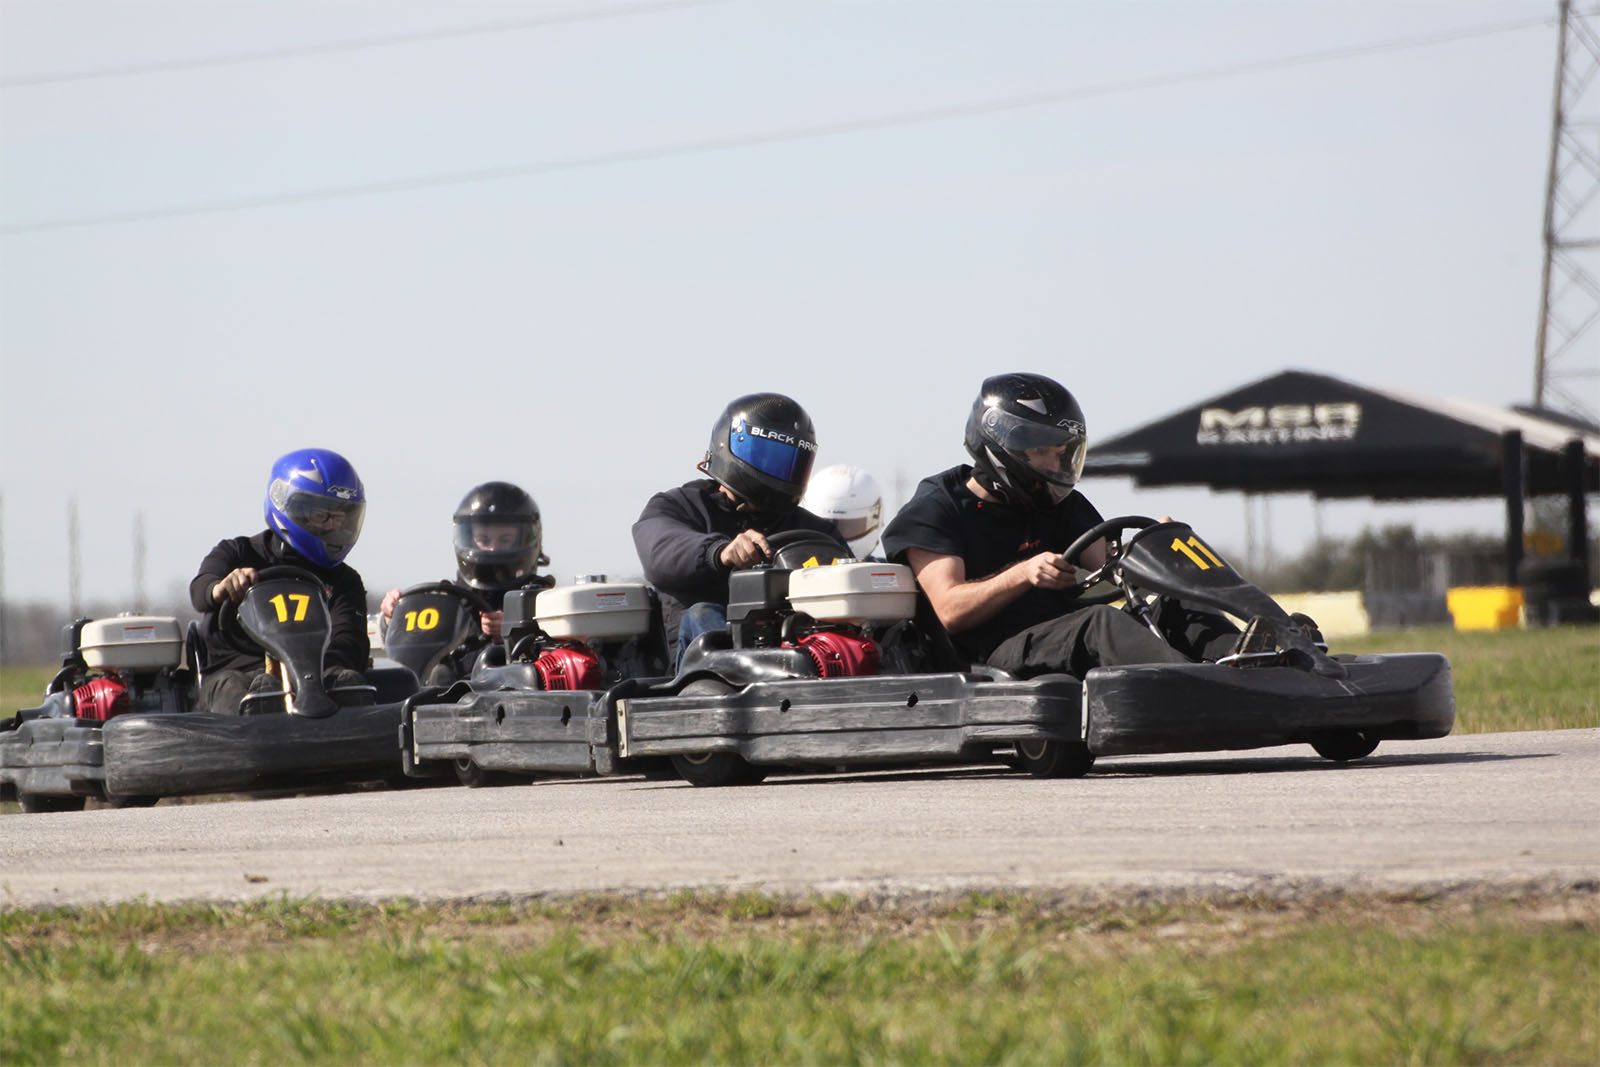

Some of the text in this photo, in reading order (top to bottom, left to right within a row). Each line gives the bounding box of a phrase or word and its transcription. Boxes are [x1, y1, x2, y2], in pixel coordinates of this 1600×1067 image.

[751, 426, 795, 444] BLACK
[1170, 535, 1225, 570] 11
[268, 593, 310, 623] 17
[405, 608, 439, 631] 10
